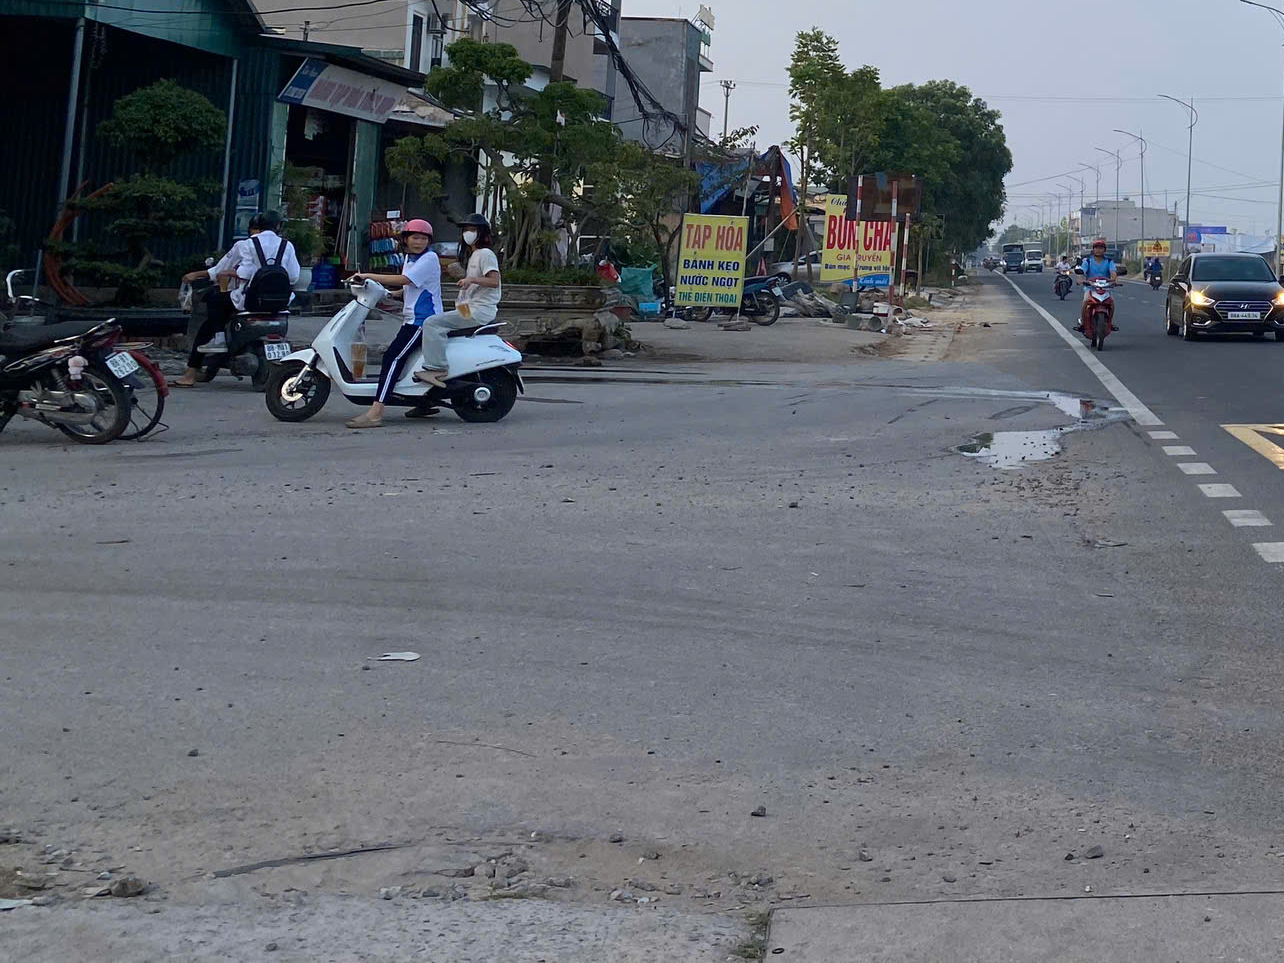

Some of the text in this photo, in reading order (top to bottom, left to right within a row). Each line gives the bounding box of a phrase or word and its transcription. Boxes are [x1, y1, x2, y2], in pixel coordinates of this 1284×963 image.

[686, 221, 743, 255] TẠP HÓA
[683, 257, 740, 273] BÁNH KẸO
[836, 253, 851, 262] GIA
[680, 273, 740, 289] NƯỚC NGỌT
